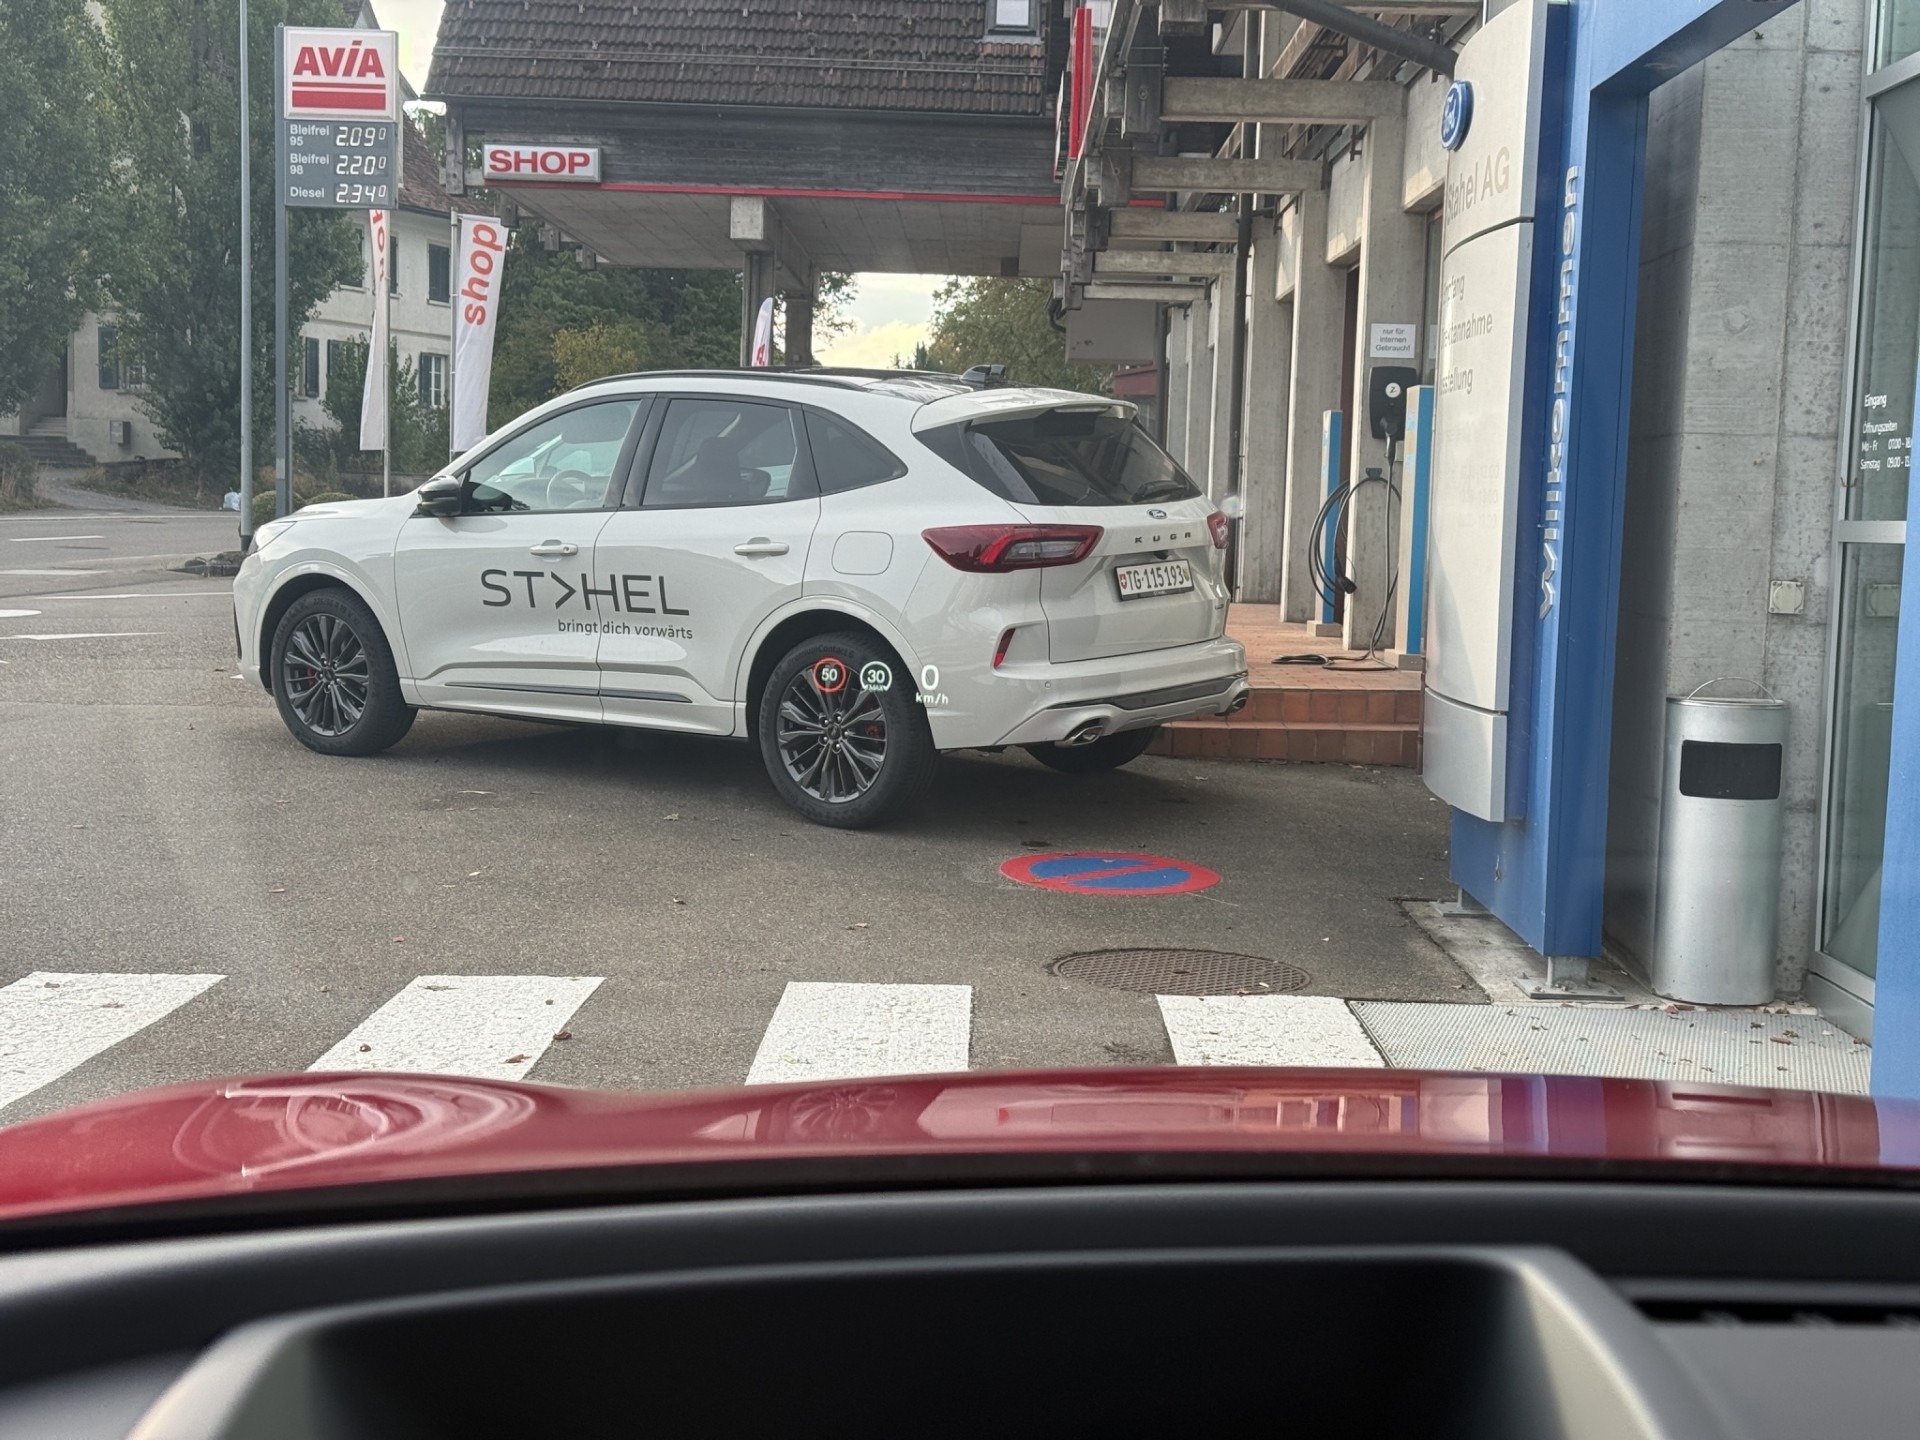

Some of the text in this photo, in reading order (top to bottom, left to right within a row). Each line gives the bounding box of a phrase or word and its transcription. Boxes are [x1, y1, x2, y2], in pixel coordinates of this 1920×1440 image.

[292, 40, 385, 78] AVIA
[289, 124, 330, 136] Bleifrei
[289, 137, 304, 146] 95
[289, 153, 330, 165] Bleifrei
[489, 149, 591, 174] SHOP
[289, 165, 304, 175] 98
[1481, 146, 1510, 201] AG
[289, 186, 325, 198] Diesel
[460, 222, 504, 326] shop
[1539, 165, 1579, 620] Willkommen
[1864, 394, 1887, 409] Eingang
[1860, 459, 1881, 471] Samstag
[1134, 531, 1192, 544] KUGA
[557, 619, 693, 640] bringt dich vorwärts
[821, 667, 838, 682] 50
[867, 669, 886, 684] 30
[921, 664, 940, 691] 0
[915, 692, 949, 704] km/h
